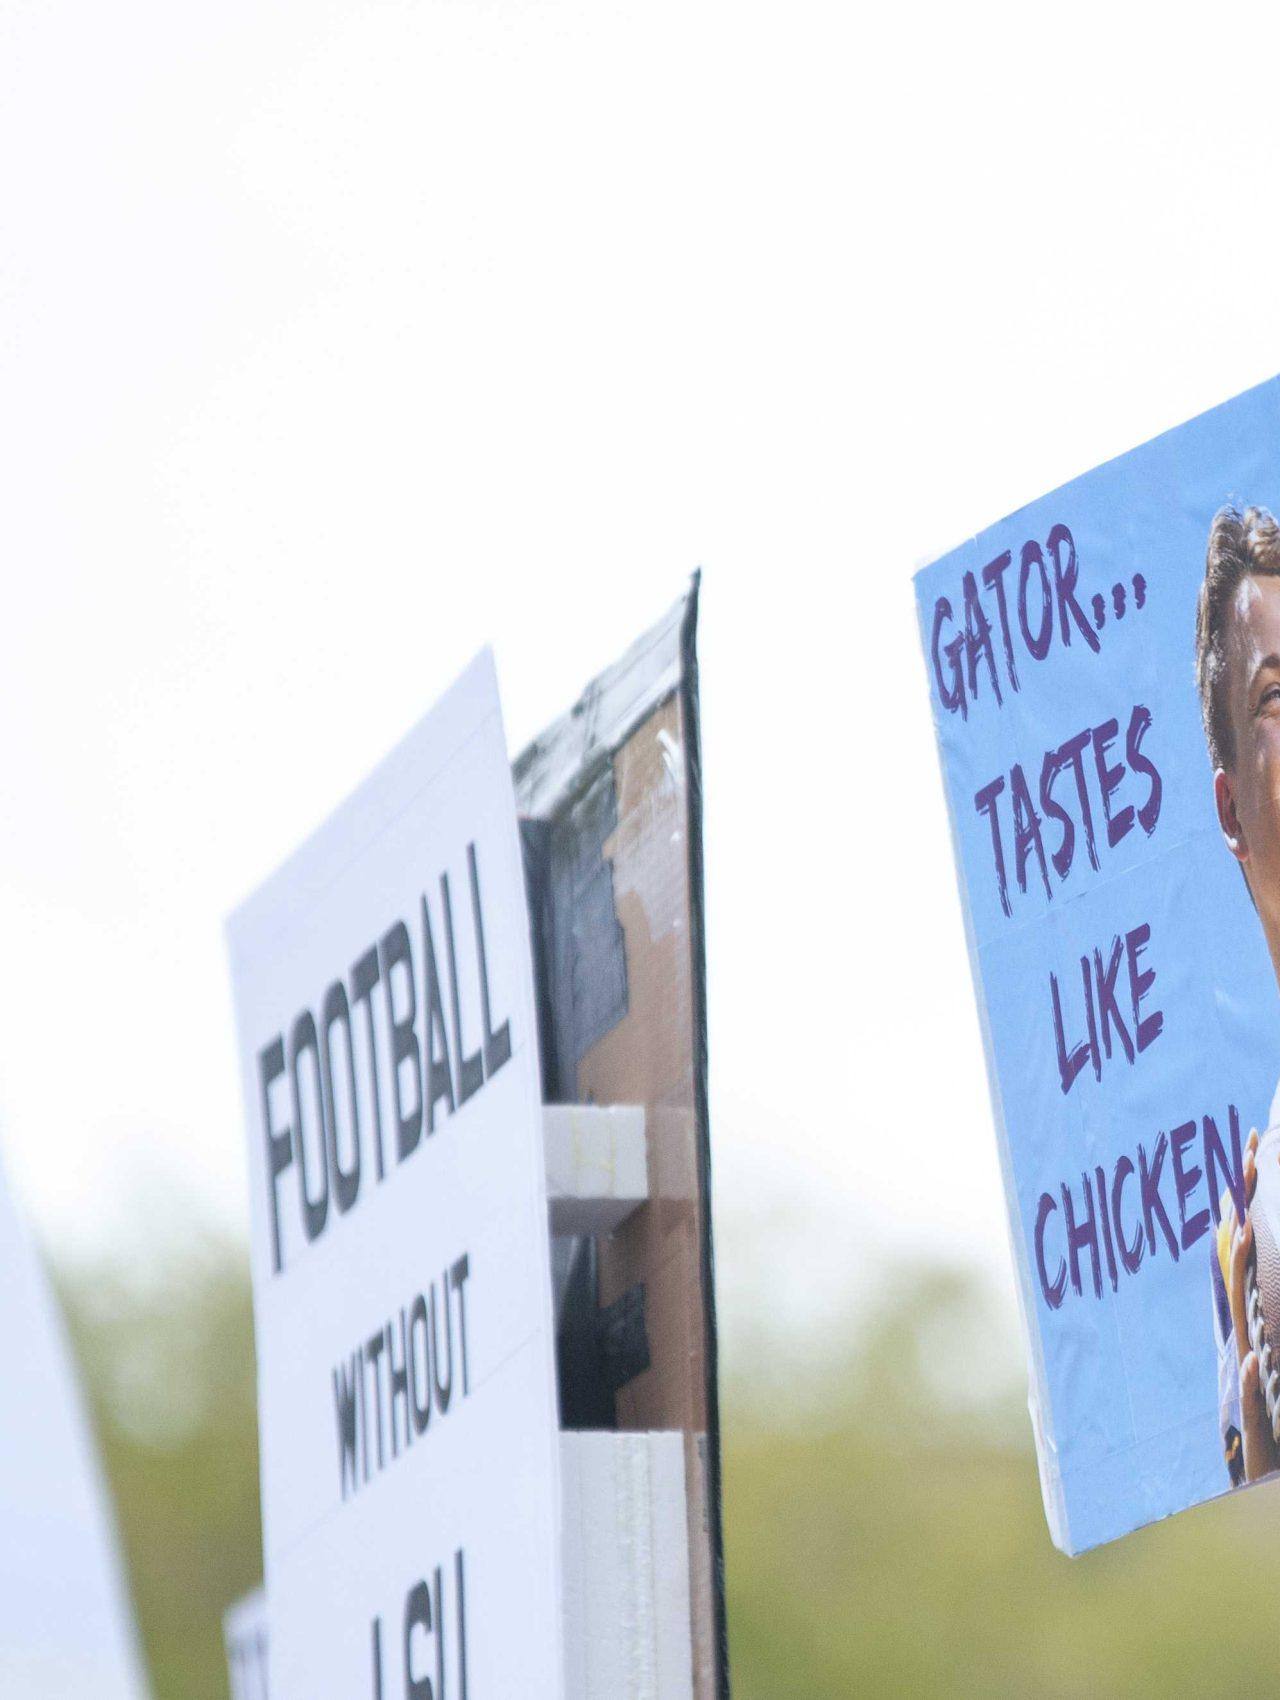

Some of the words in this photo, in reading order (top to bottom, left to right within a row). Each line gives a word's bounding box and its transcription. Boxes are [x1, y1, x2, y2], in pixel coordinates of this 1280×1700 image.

[931, 523, 1147, 721] GATOR...
[974, 704, 1163, 918] TASTES
[257, 841, 512, 1274] FOOTBALL
[1050, 923, 1164, 1095] LIKE
[1034, 1104, 1246, 1310] CHICKEN
[331, 1252, 470, 1501] WITHOUT
